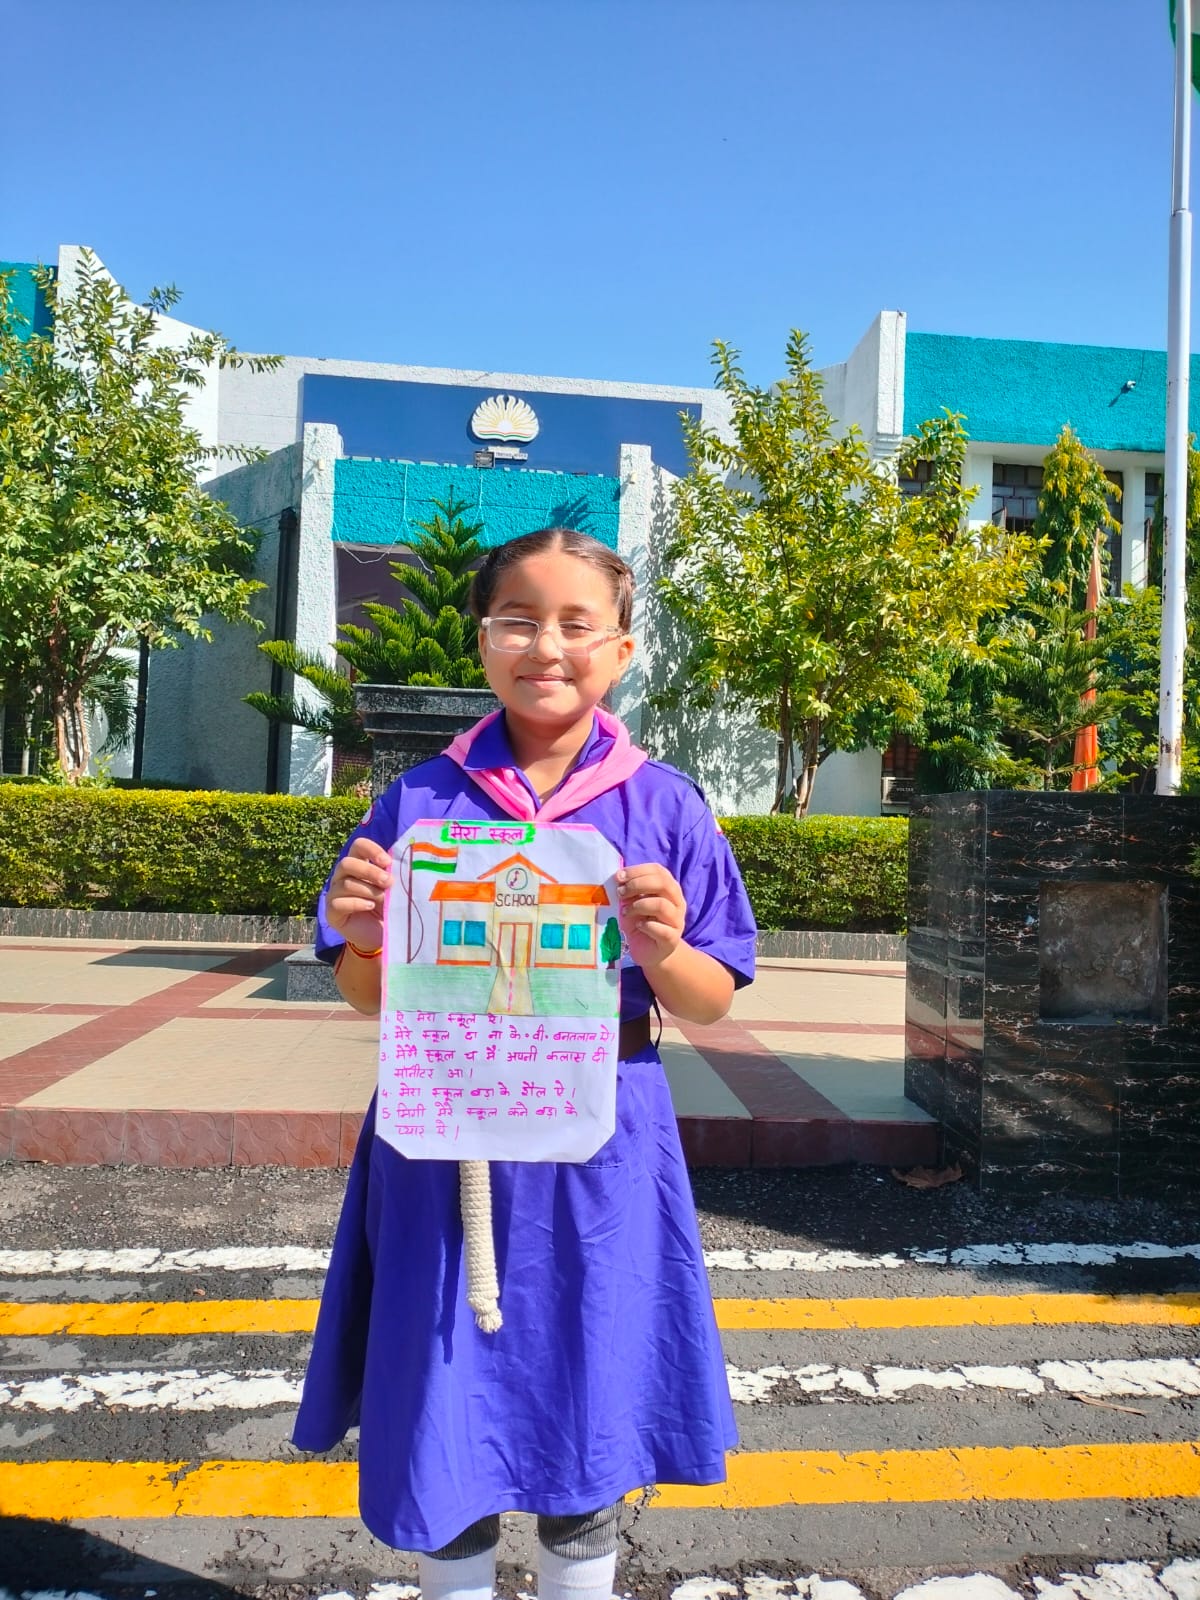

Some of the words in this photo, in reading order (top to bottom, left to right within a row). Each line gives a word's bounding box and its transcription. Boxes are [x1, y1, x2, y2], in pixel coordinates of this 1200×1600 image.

[450, 821, 482, 841] मेरा
[489, 828, 524, 845] स्कूल
[495, 893, 539, 907] SCHOOL
[417, 1010, 436, 1022] मेरा
[448, 1013, 476, 1029] स्कूल
[394, 1026, 413, 1041] मेरे
[422, 1030, 450, 1043] स्कूल
[424, 1050, 456, 1063] स्कूल
[400, 1082, 421, 1097] मेरा
[432, 1087, 464, 1102] स्कूल
[466, 1107, 498, 1120] स्कूल
[394, 1124, 425, 1138] प्यार
